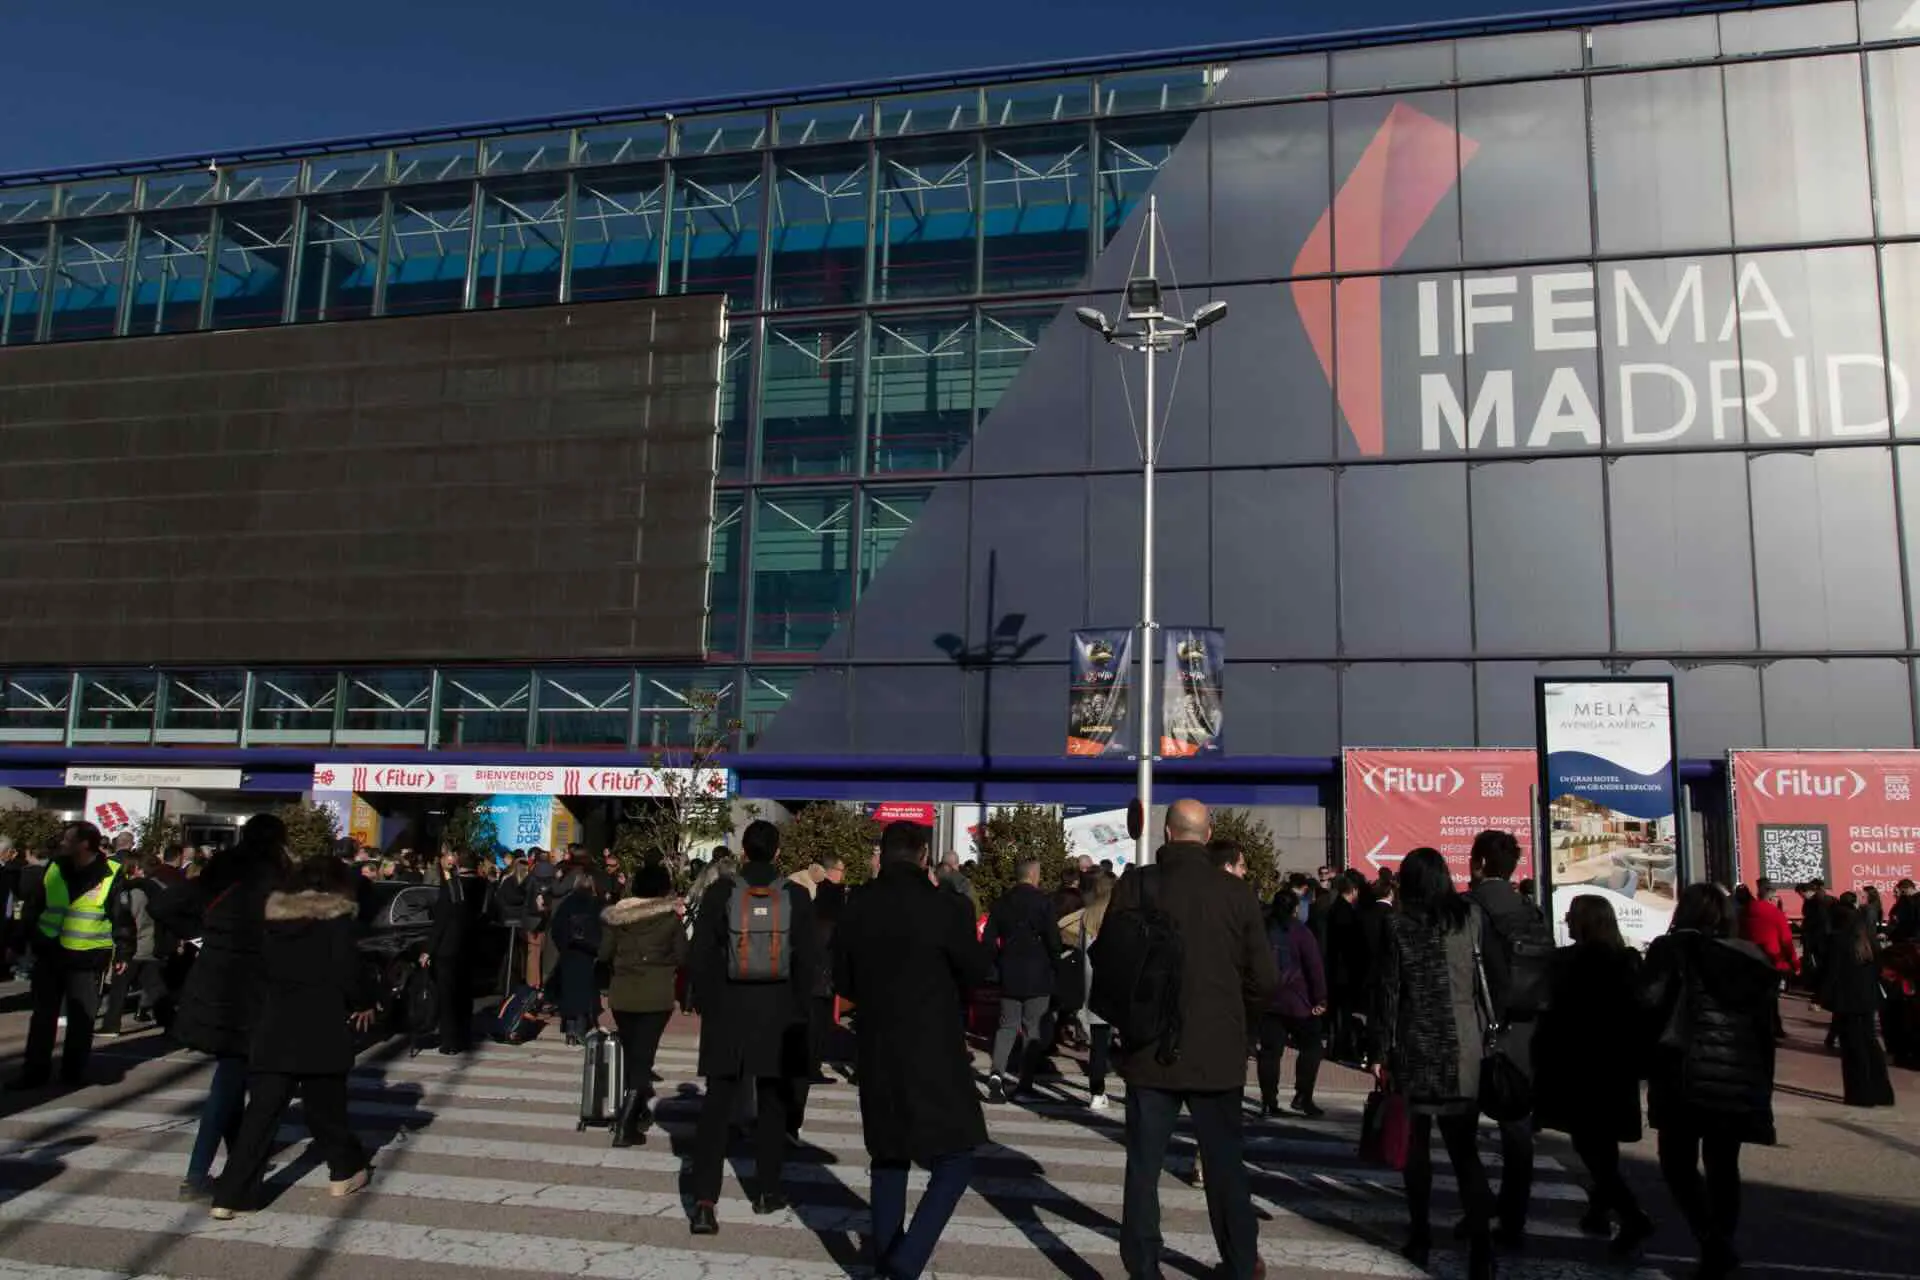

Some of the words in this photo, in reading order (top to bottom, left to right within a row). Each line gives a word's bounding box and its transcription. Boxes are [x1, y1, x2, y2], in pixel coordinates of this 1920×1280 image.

[1417, 261, 1795, 357] IFEMA
[1419, 353, 1911, 451] MADRID
[1574, 696, 1641, 716] MELIÁ
[1560, 720, 1605, 730] AVENIDA
[103, 772, 118, 783] Sur
[386, 769, 425, 786] Fitur
[475, 770, 554, 781] BIENVENIDOS
[601, 772, 643, 791] Fitur
[1384, 767, 1446, 793] Fitur
[1776, 769, 1847, 797] Fitur
[485, 781, 544, 792] WELCOME
[1440, 816, 1487, 825] ACCESO
[1851, 841, 1915, 854] ONLINE
[1852, 864, 1912, 877] ONLINE
